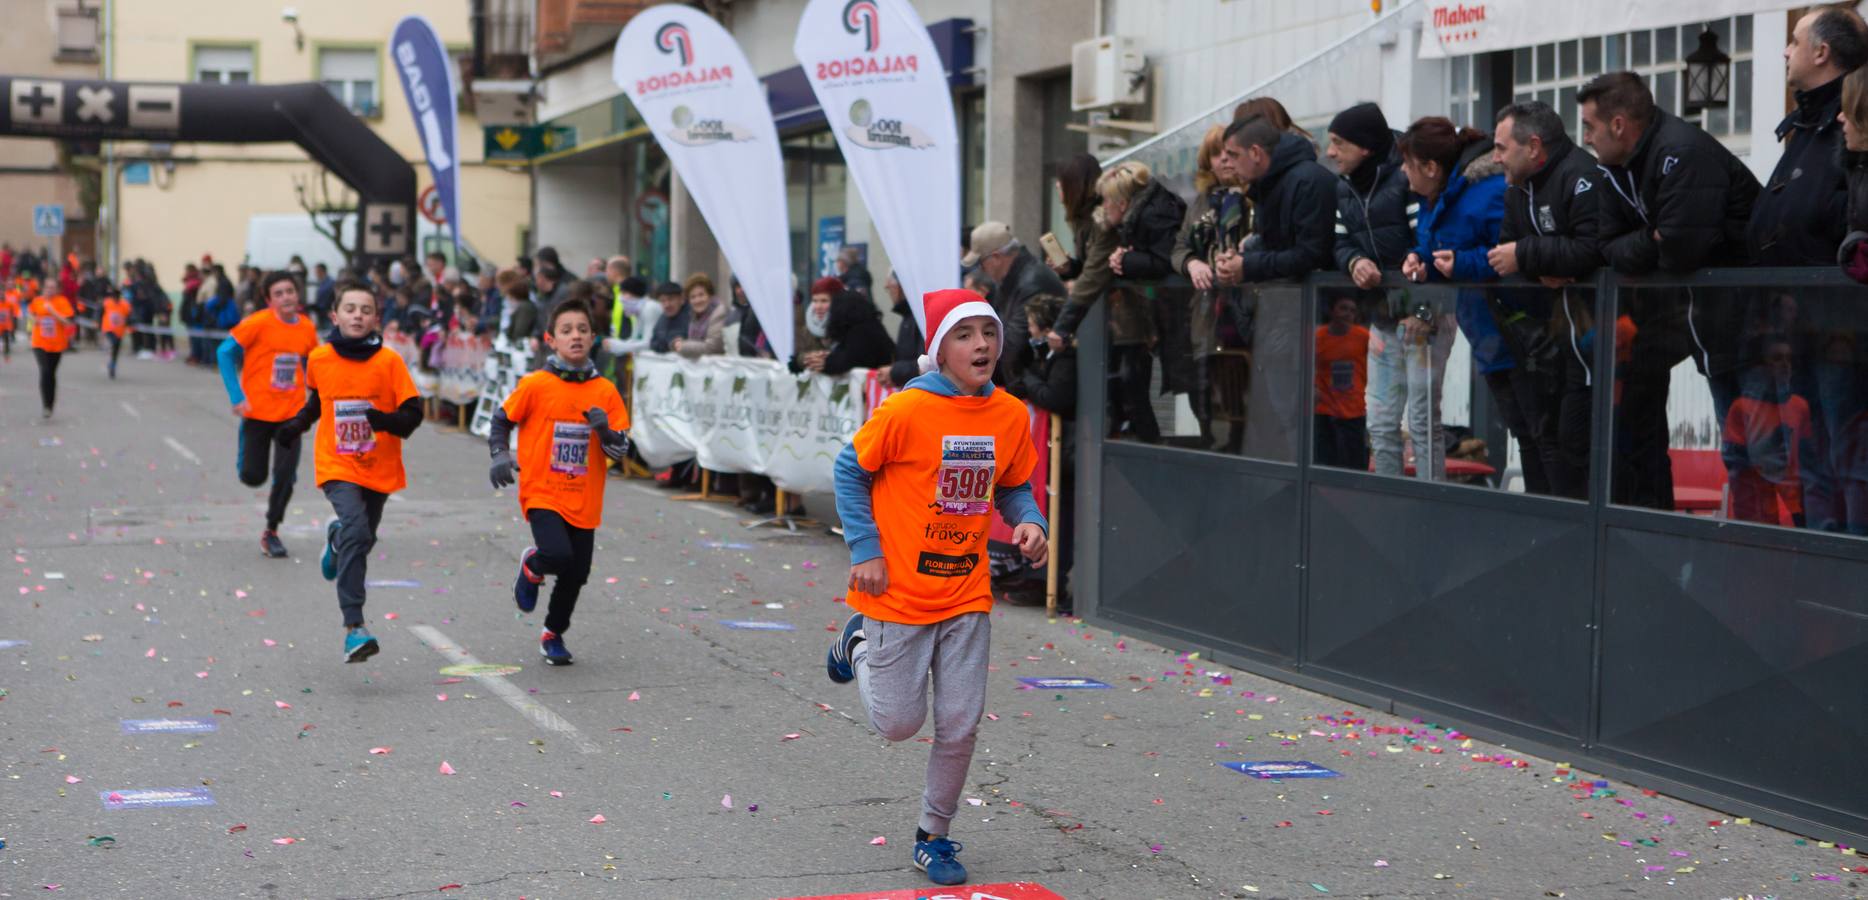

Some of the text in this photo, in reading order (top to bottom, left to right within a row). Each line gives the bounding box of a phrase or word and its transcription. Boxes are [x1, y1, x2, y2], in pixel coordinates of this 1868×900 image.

[1434, 4, 1486, 27] Mahou
[339, 422, 372, 442] 285
[557, 442, 587, 464] 1393
[942, 468, 990, 499] 598
